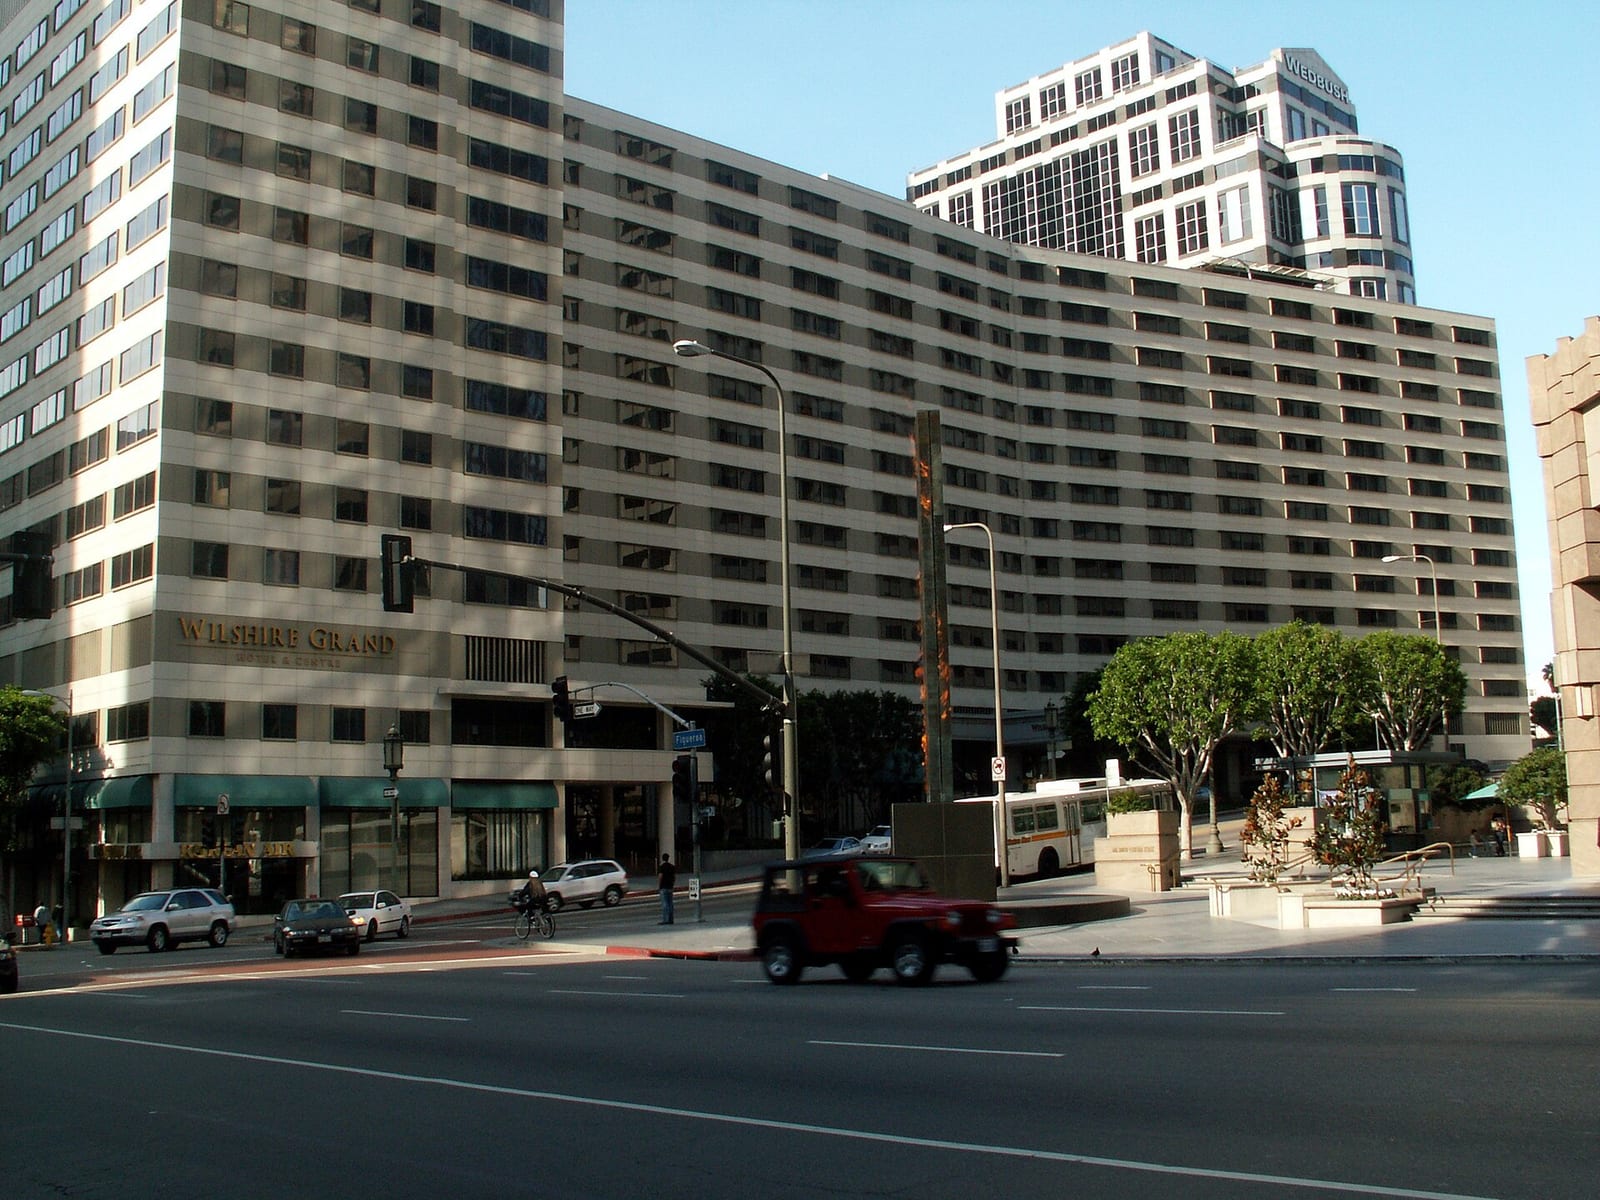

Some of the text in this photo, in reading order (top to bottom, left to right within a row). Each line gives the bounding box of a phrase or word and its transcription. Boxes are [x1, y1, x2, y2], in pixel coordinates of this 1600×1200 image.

[1284, 52, 1348, 103] WEDBUSH
[178, 614, 396, 654] WILSHIRE GRAND
[675, 734, 703, 745] Figueroa
[263, 842, 295, 857] AIR
